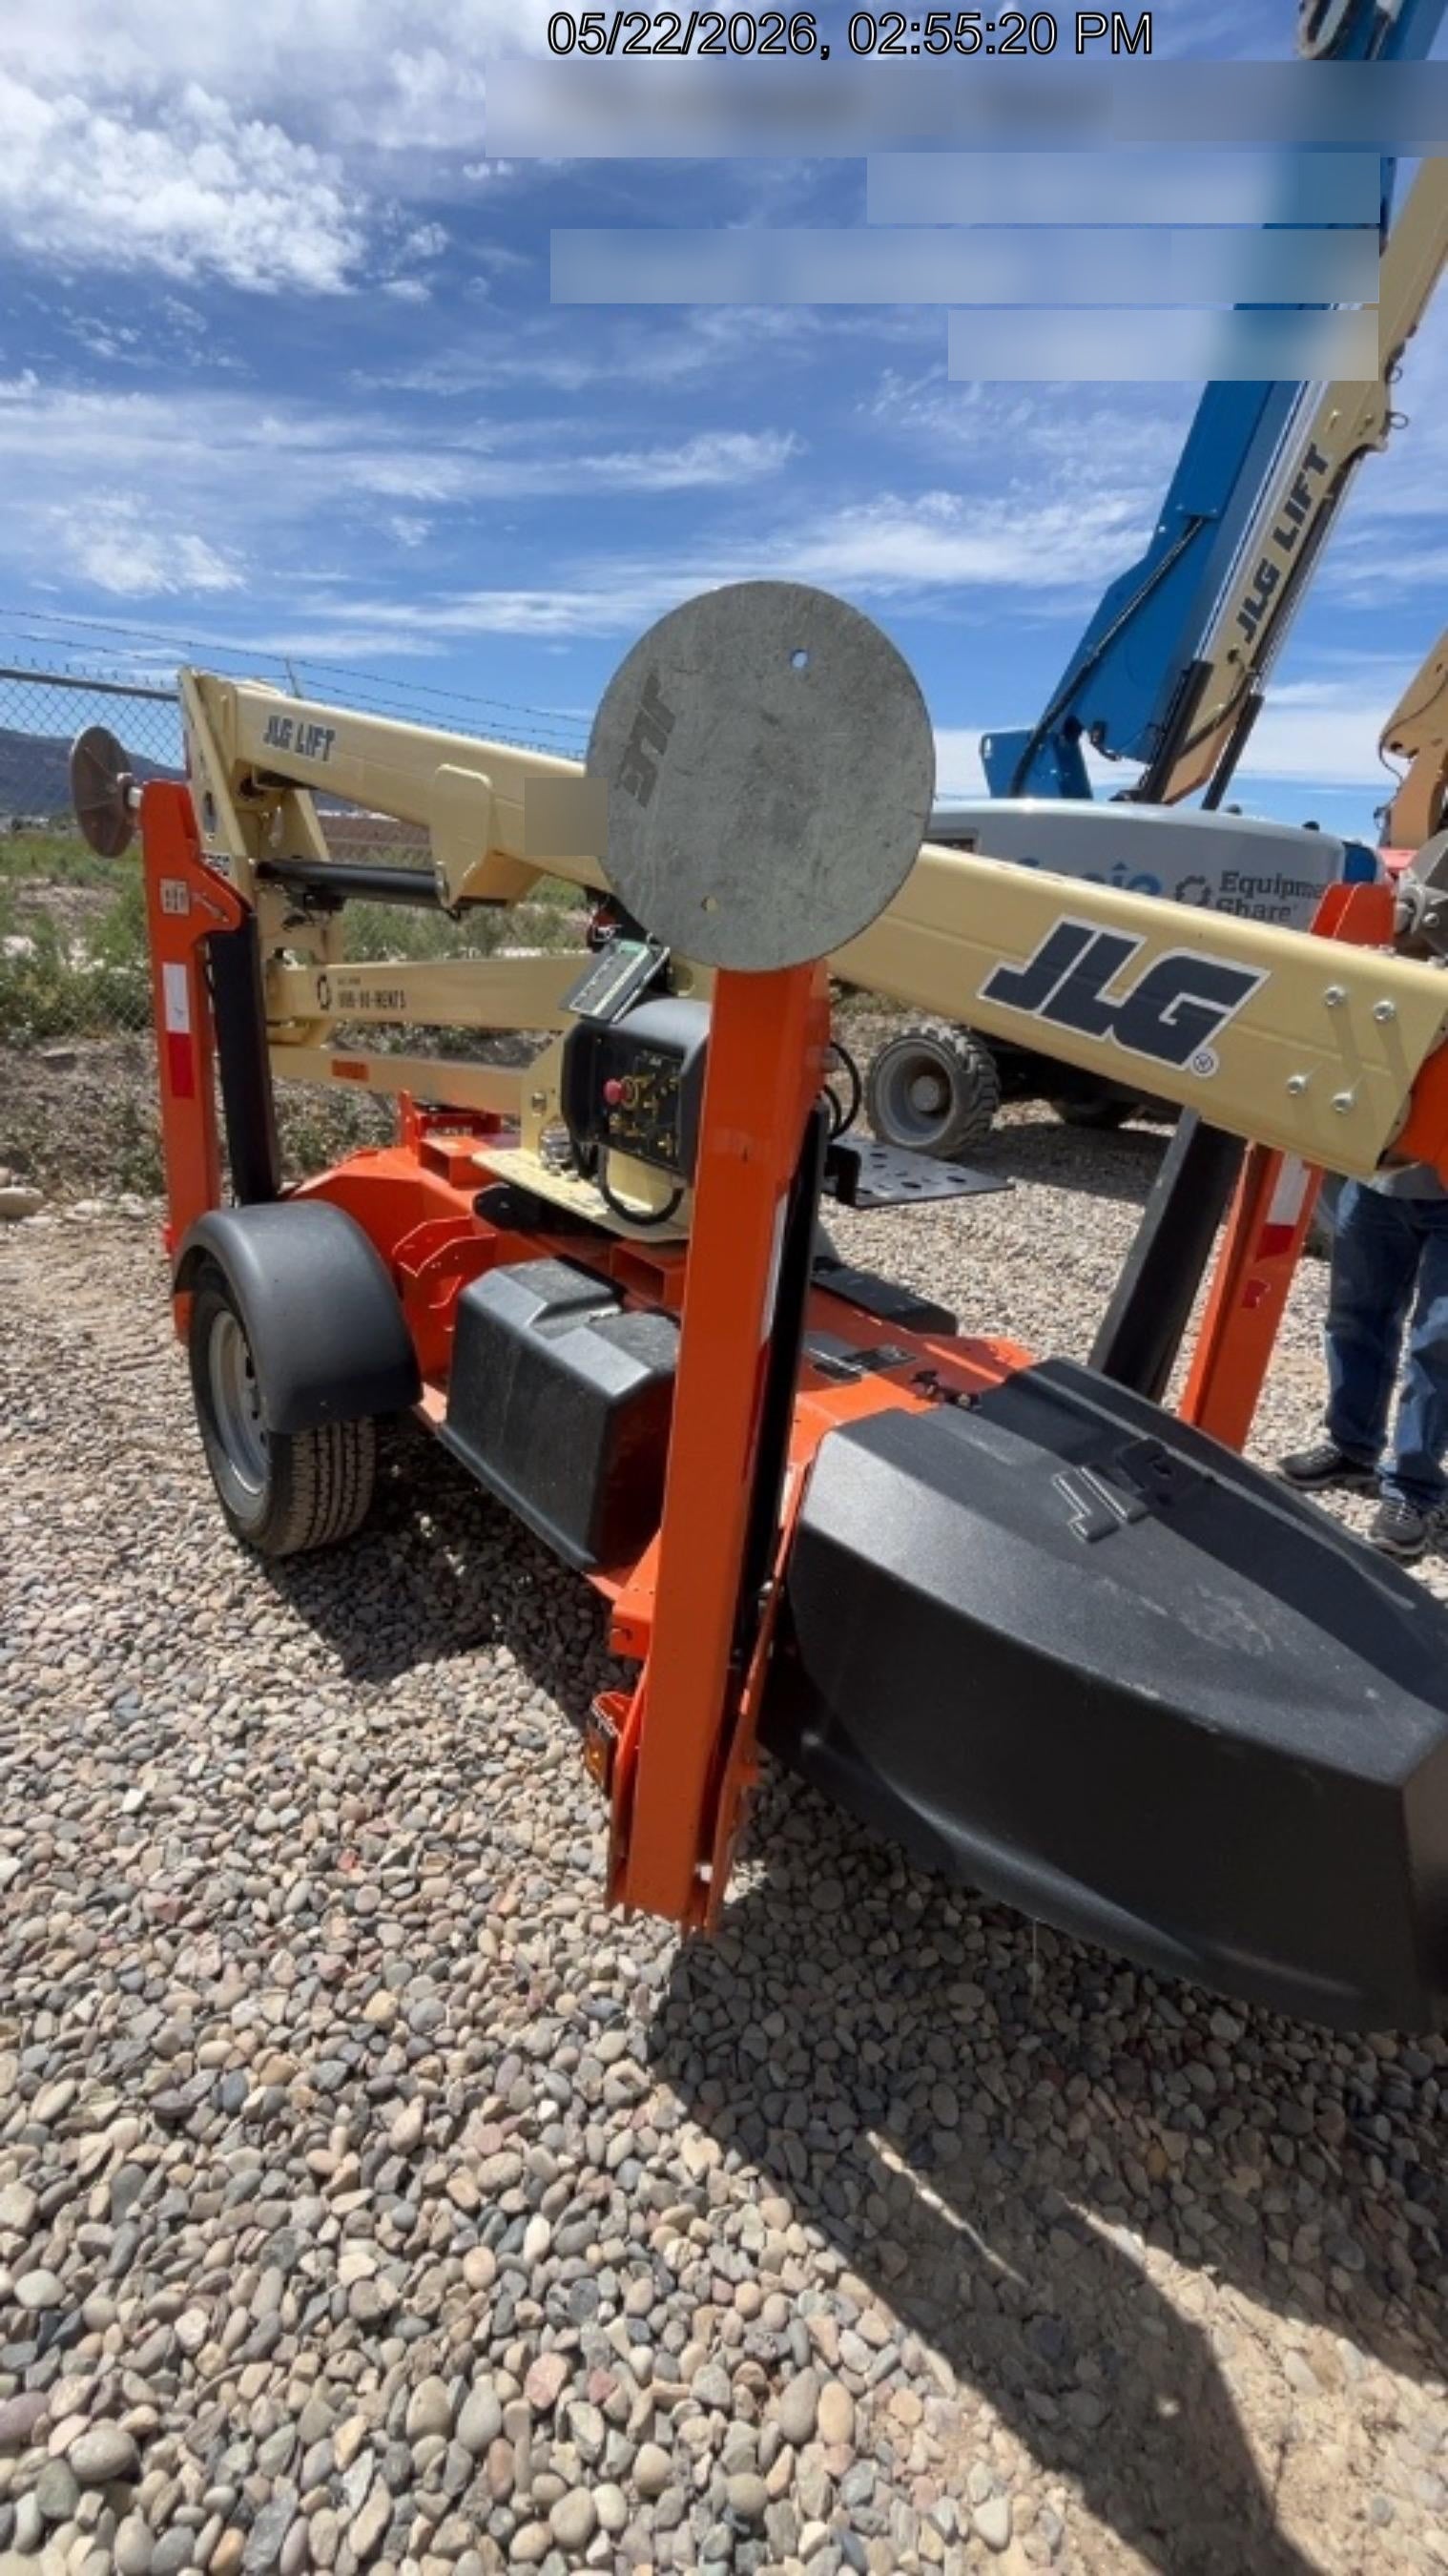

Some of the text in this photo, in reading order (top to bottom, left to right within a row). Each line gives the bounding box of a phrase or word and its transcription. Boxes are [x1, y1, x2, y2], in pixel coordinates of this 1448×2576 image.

[1236, 442, 1329, 644] JLG LIFT
[262, 715, 336, 762] JLG LIFT
[979, 916, 1270, 1070] JLG
